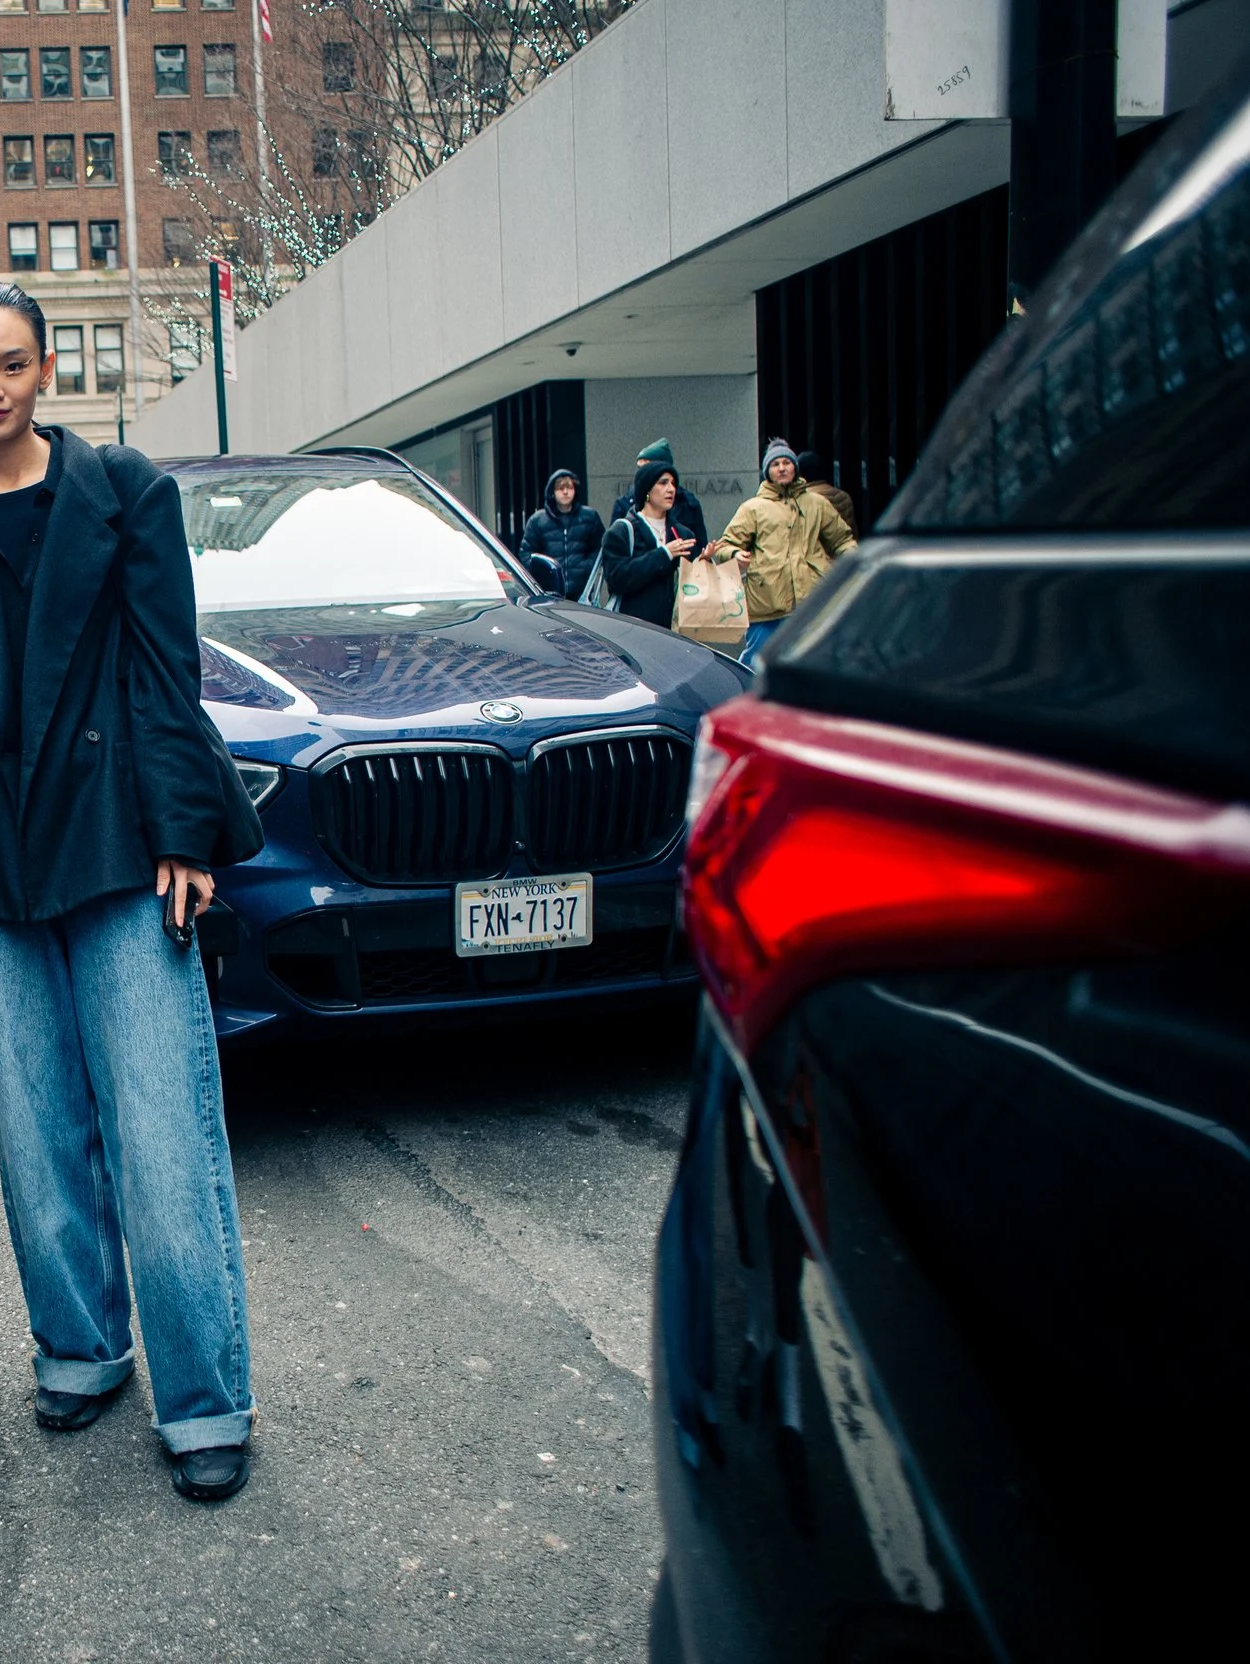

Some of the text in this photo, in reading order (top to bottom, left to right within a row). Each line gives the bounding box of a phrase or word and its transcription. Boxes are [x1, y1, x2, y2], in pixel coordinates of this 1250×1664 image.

[937, 65, 971, 96] 25859
[684, 478, 743, 495] PLAZA
[491, 882, 558, 900] NEW YORK
[512, 878, 538, 887] BMW
[469, 896, 579, 939] FXN 7137
[496, 939, 555, 953] TENAFLY
